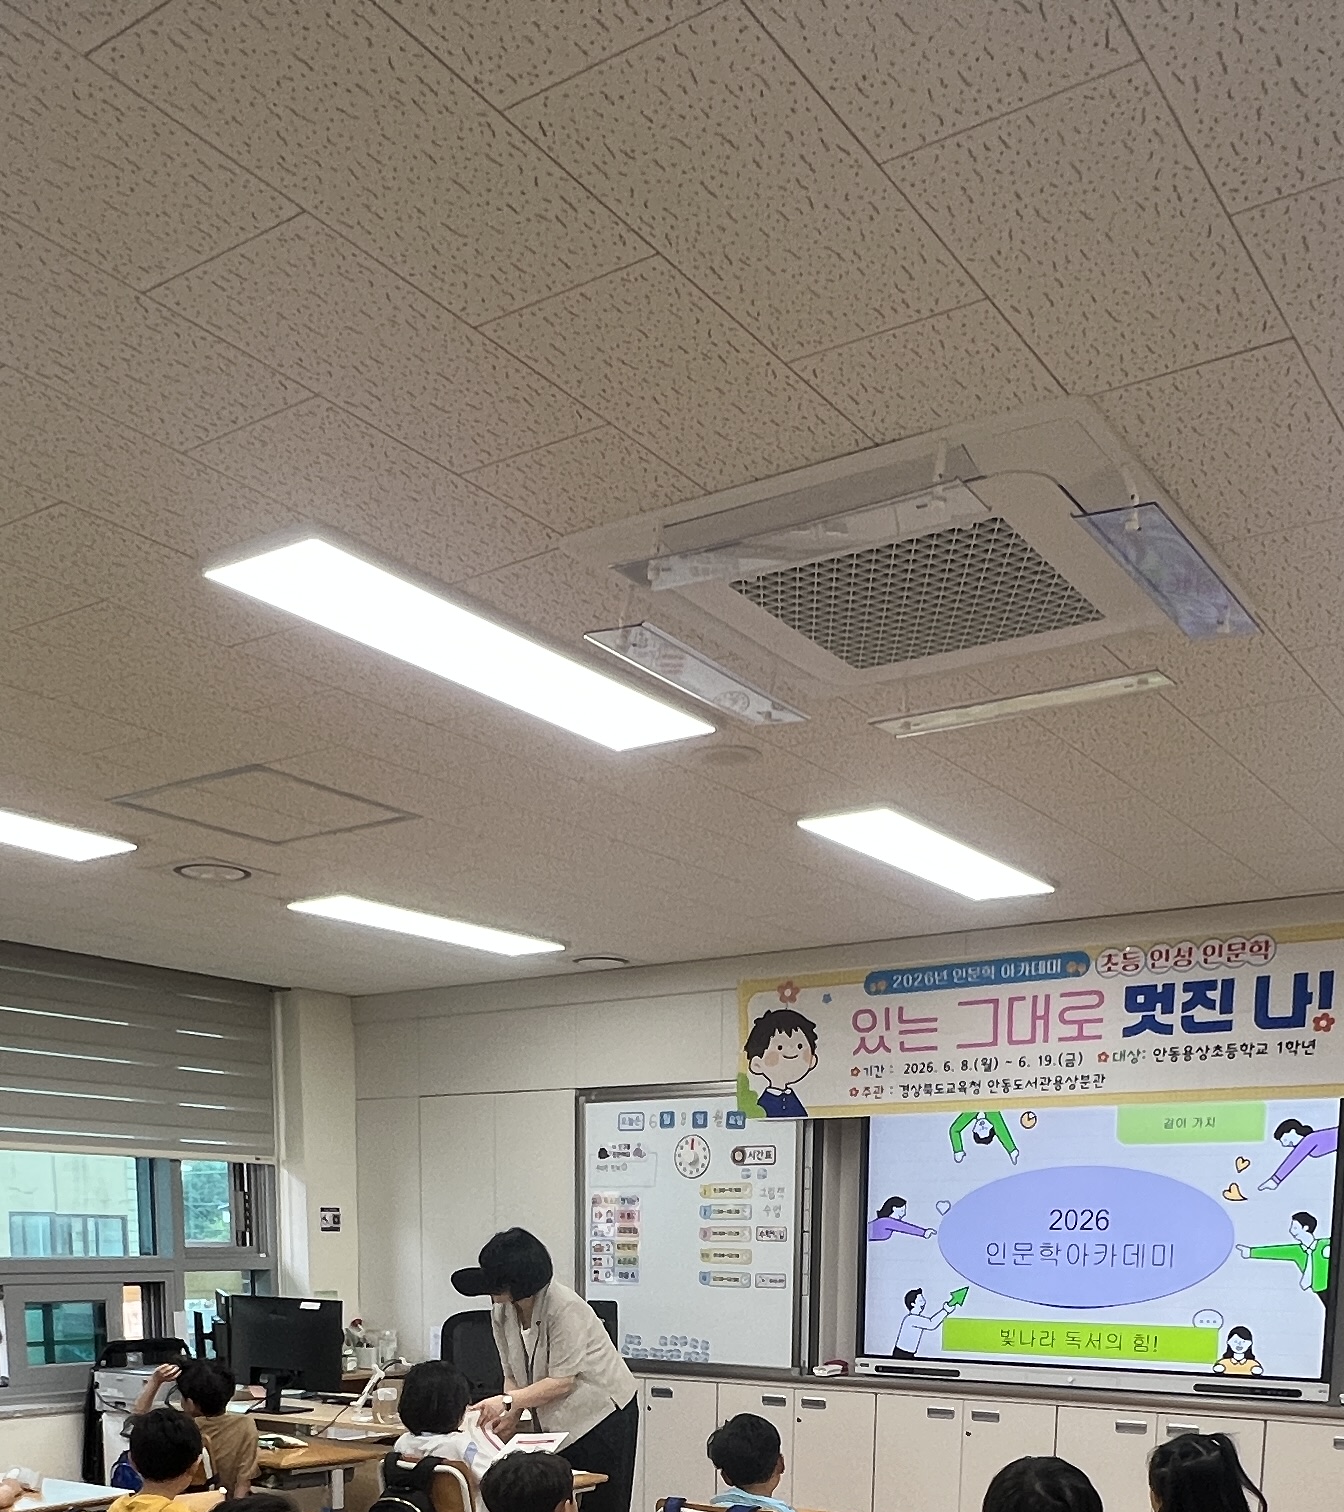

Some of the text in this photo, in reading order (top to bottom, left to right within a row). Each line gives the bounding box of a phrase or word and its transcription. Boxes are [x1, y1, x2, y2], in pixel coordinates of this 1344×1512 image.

[1100, 939, 1271, 972] 초등 인성 인문학
[892, 968, 948, 989] 2026년
[851, 1005, 939, 1056] 있는
[956, 988, 1105, 1050] 그대로
[1122, 977, 1236, 1039] 멋진
[1152, 1041, 1269, 1064] 안동용상초등학교
[1276, 1039, 1317, 1057] 1학년
[898, 1079, 982, 1099] 경상북도교육청
[747, 1149, 773, 1161] 시간표
[1048, 1208, 1111, 1232] 2026
[986, 1241, 1175, 1269] 인문학아카데미
[1000, 1328, 1159, 1353] 빛나라 독서의 힘!
